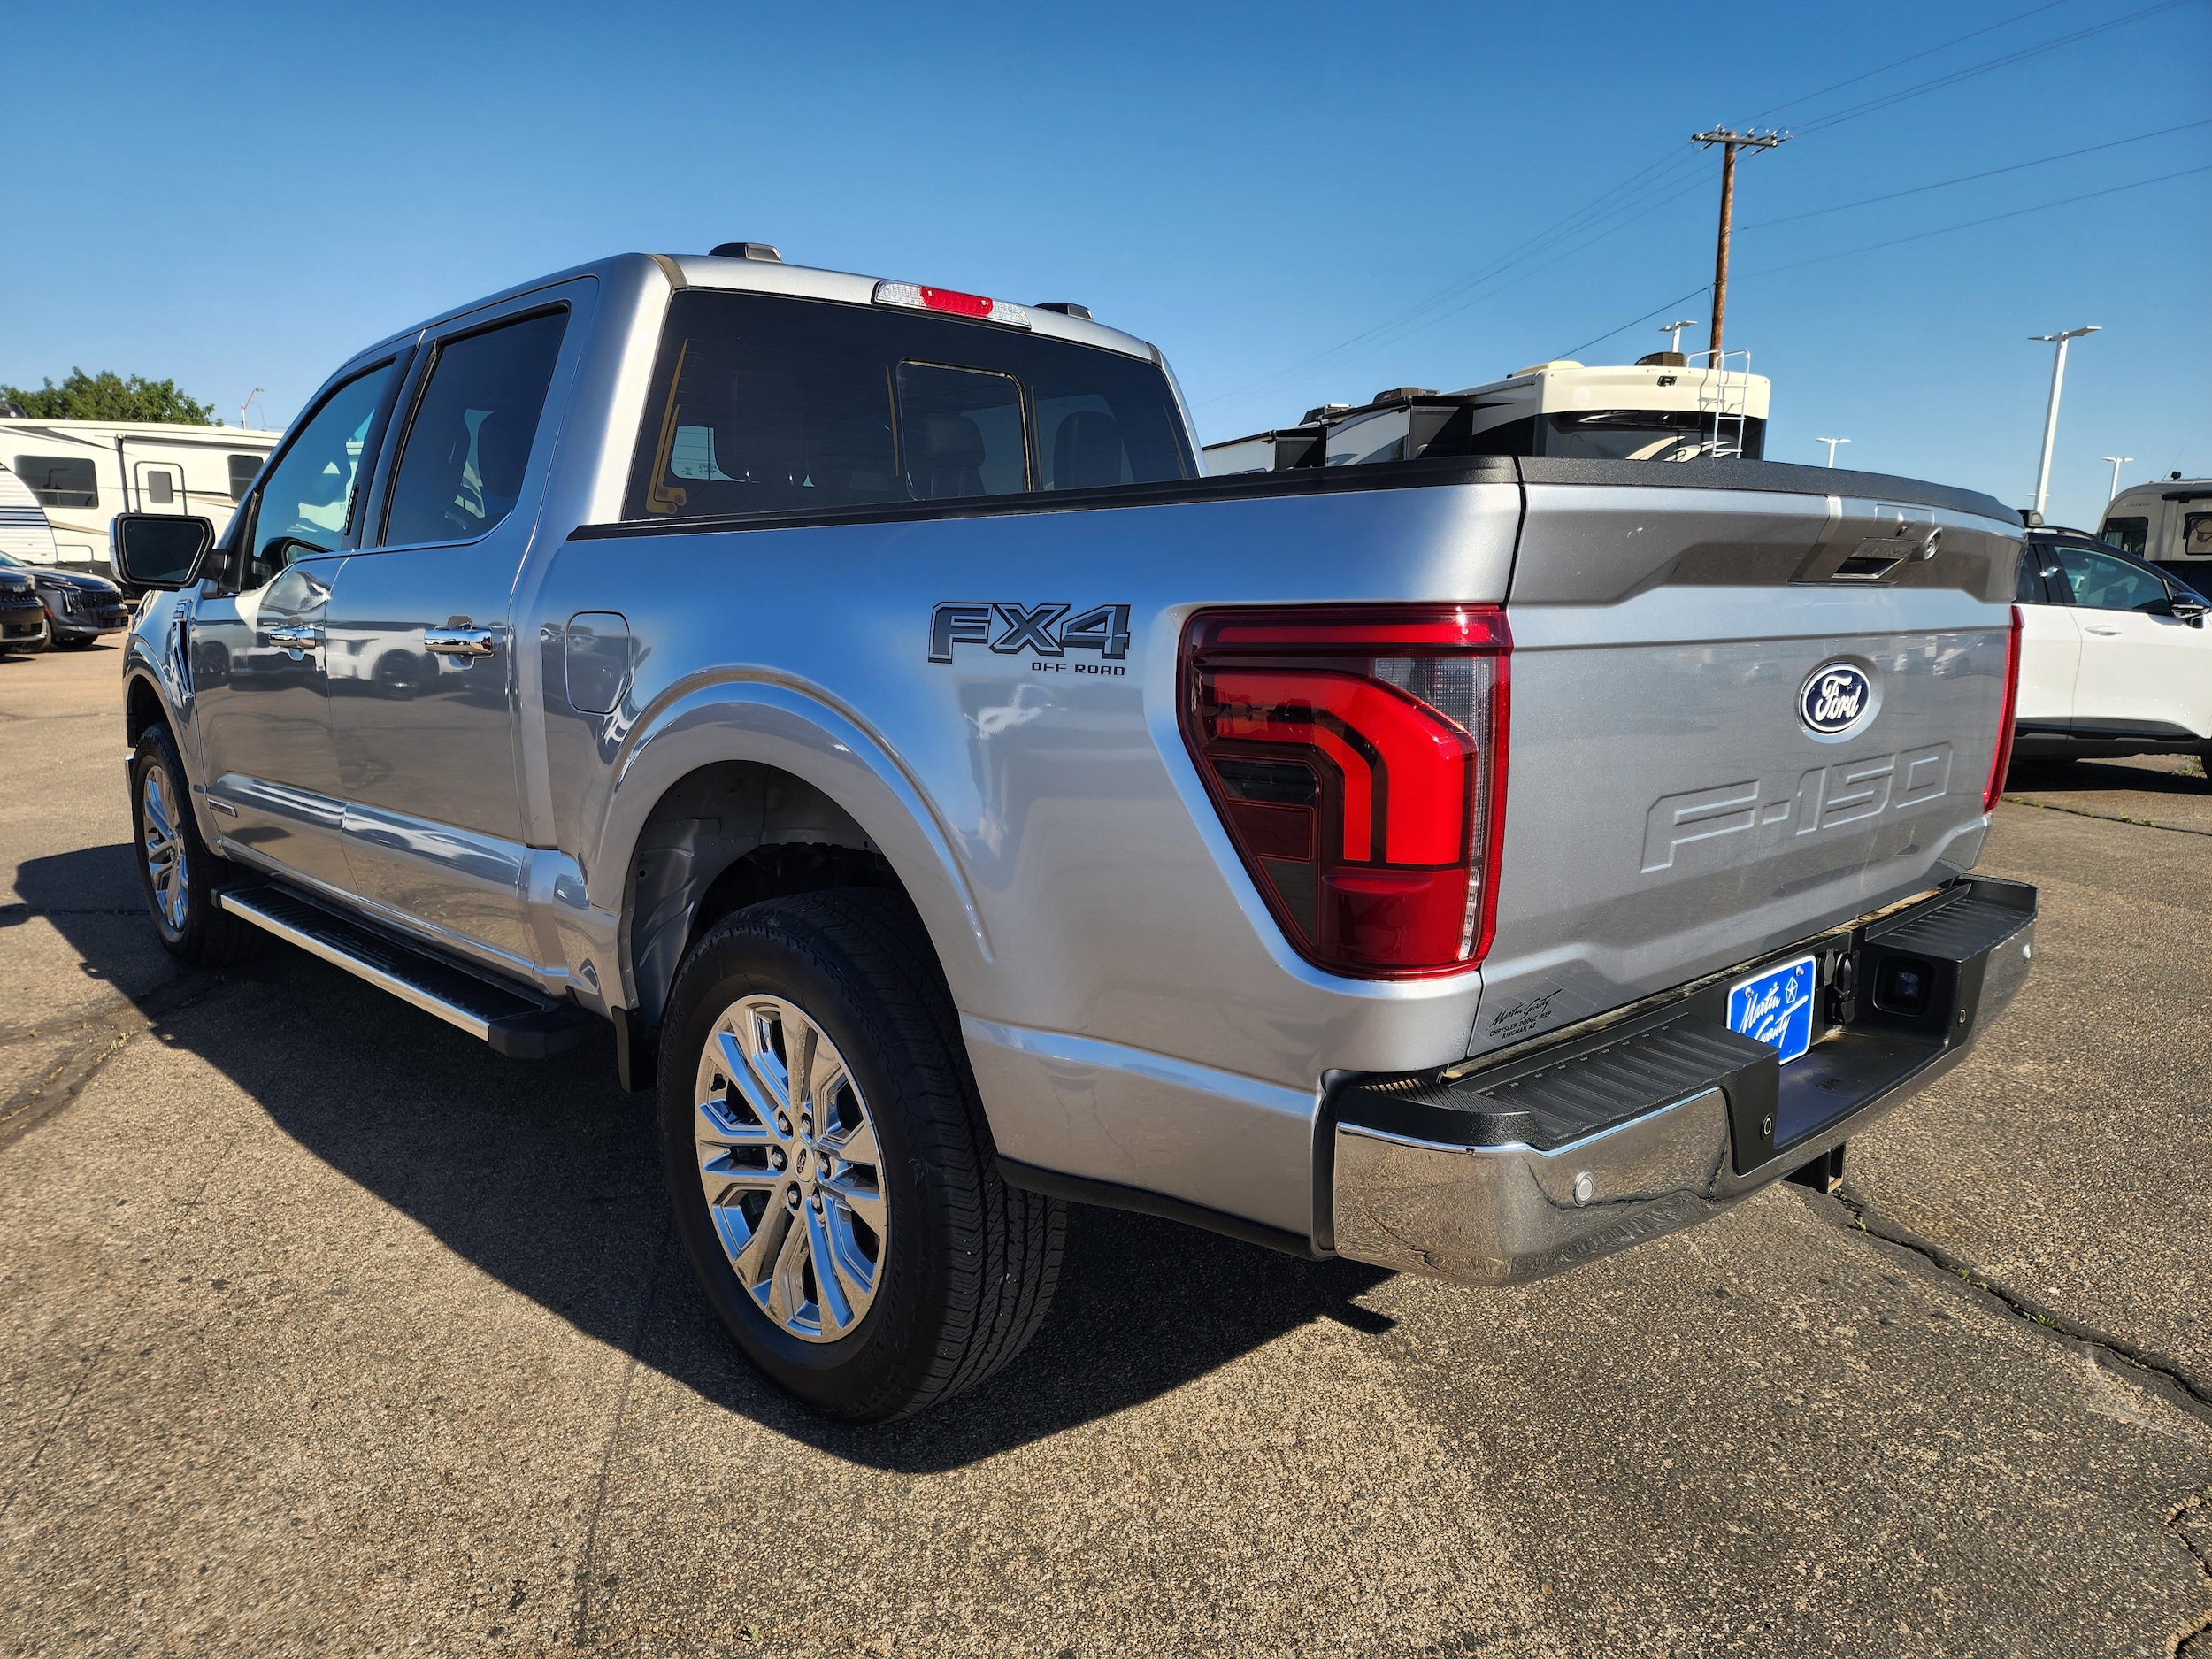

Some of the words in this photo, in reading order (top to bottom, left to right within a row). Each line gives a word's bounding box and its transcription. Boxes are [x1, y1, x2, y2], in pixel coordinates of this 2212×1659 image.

[927, 602, 1132, 664] FX4
[1031, 662, 1066, 672] OFF
[1074, 664, 1125, 676] ROAD
[1815, 675, 1863, 721] Ford
[1640, 741, 1954, 874] F-150
[1486, 1002, 1524, 1032] Martin
[1489, 1023, 1517, 1037] CHRYSLER
[1738, 981, 1782, 1034] Martin
